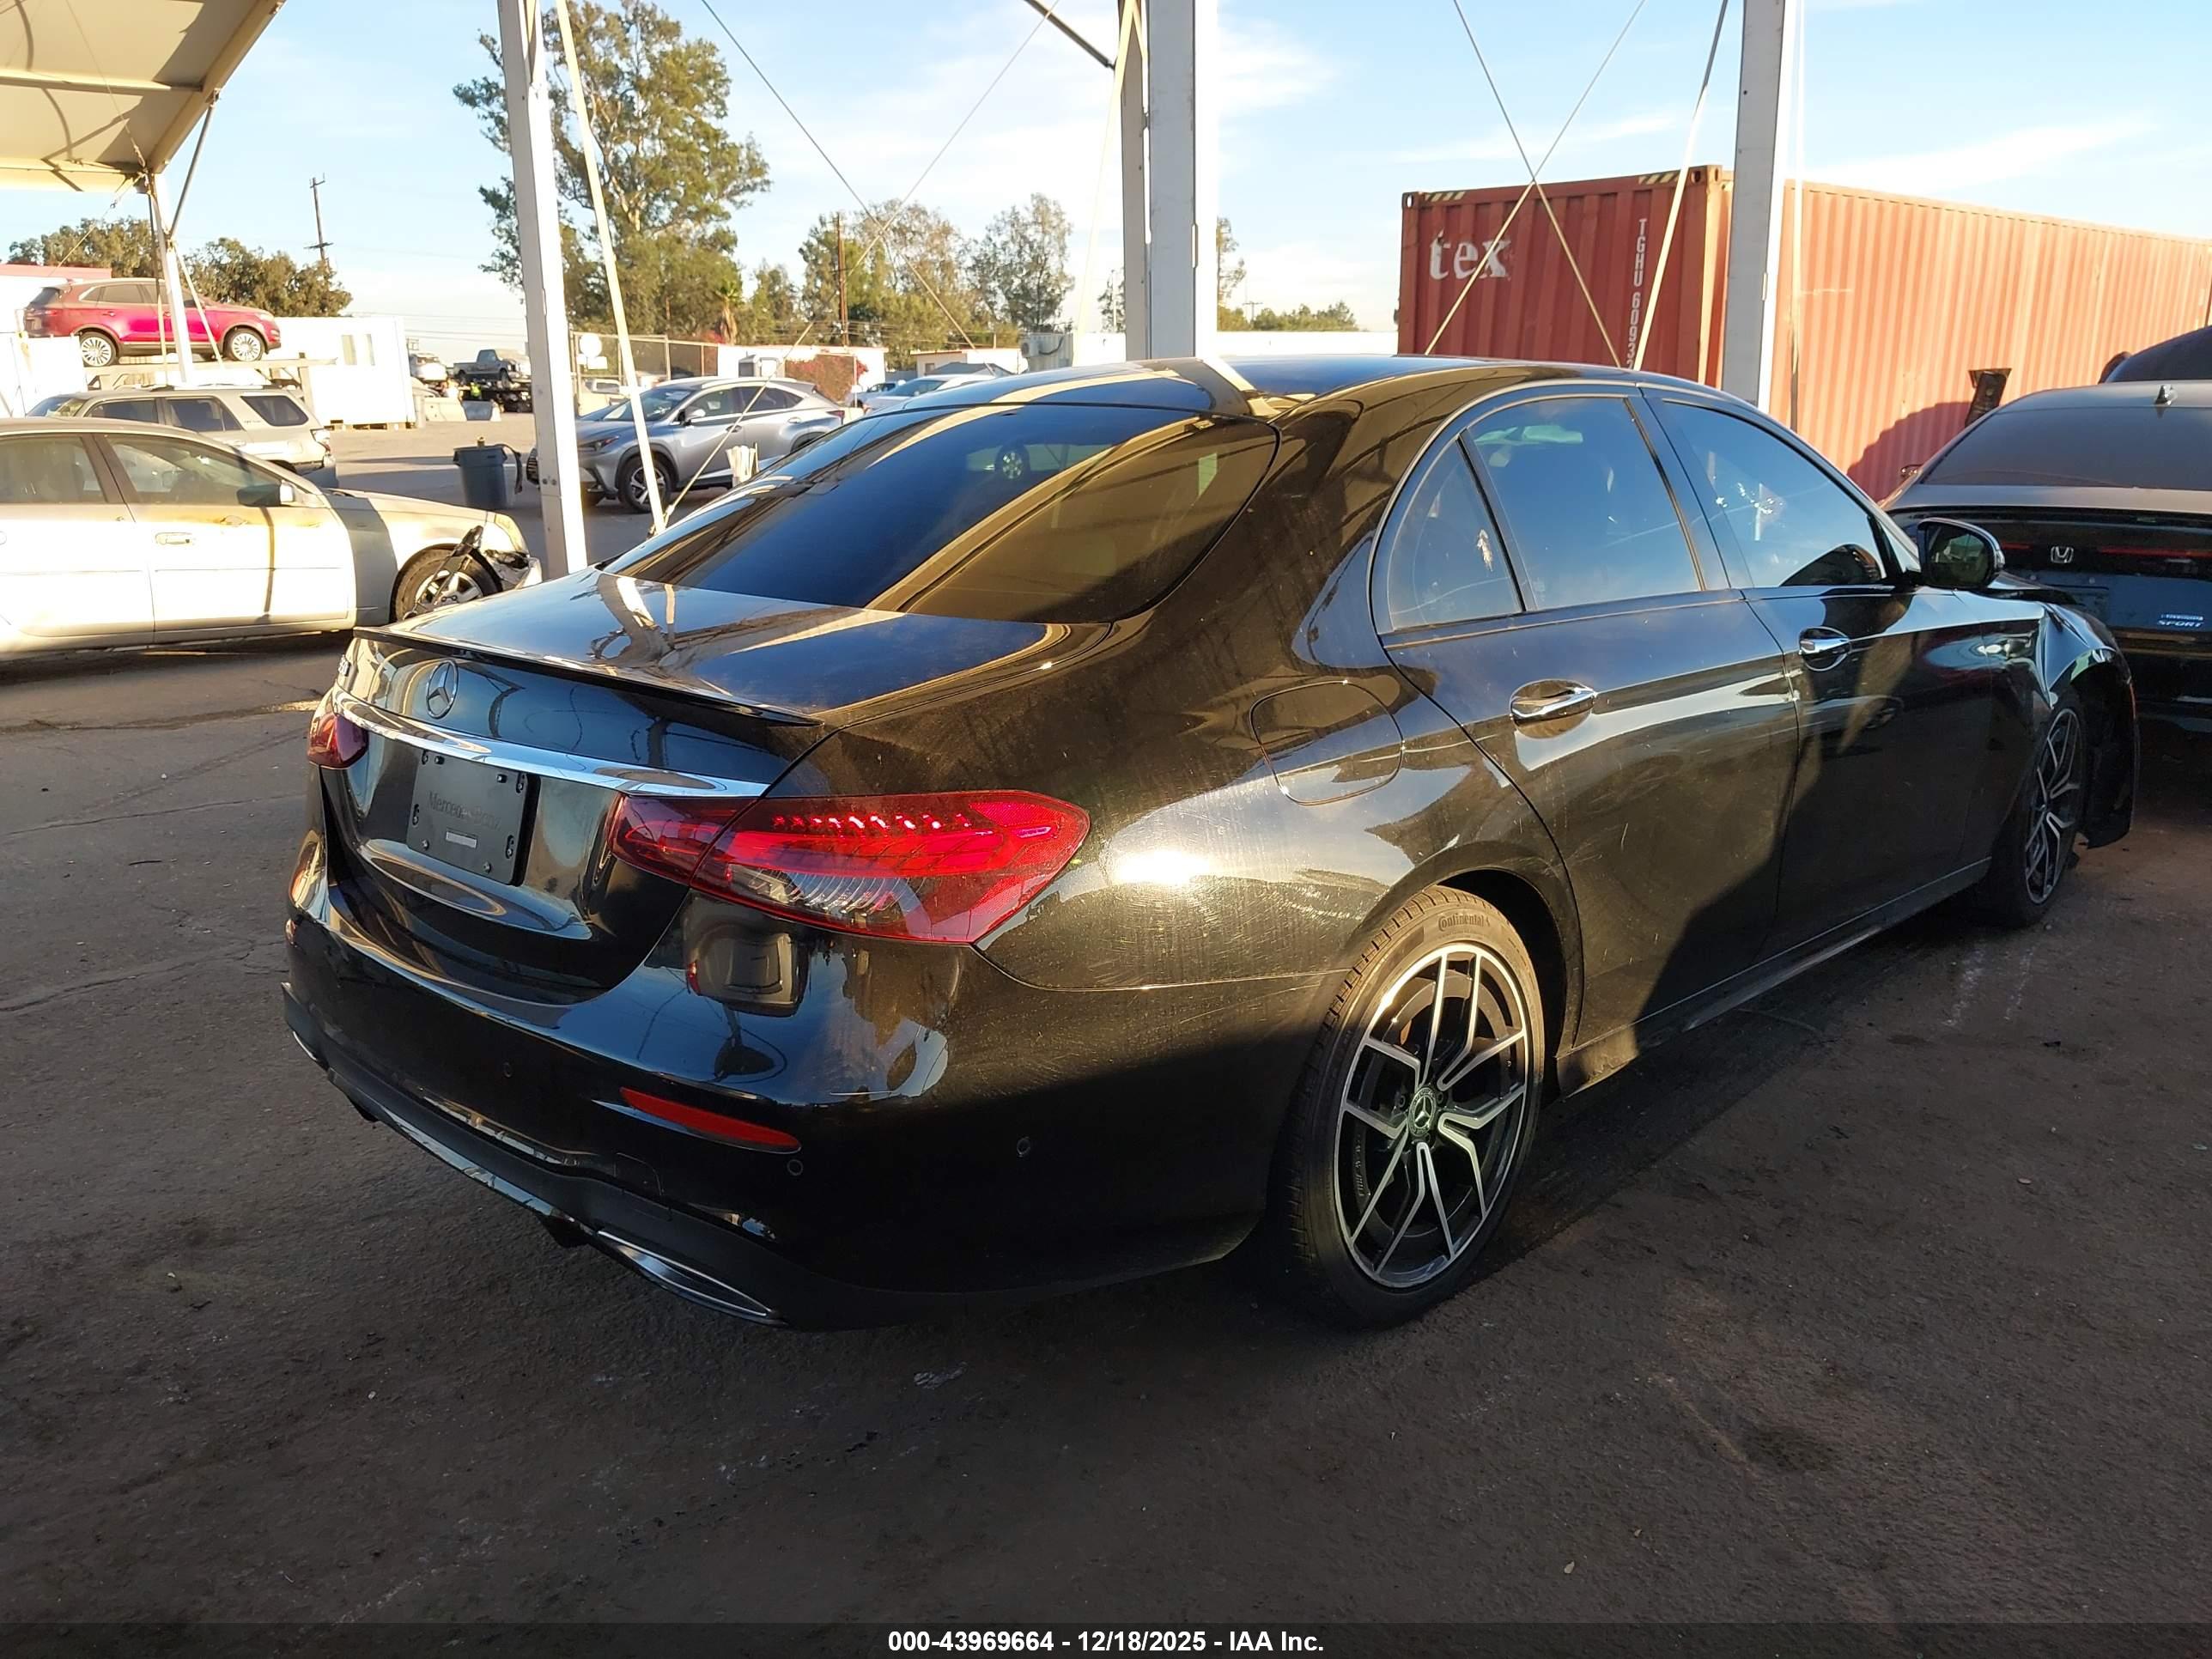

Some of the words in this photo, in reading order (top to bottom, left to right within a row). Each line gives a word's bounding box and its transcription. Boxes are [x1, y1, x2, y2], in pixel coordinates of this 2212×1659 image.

[1429, 228, 1511, 280] tex
[1633, 218, 1648, 287] TGHU
[1438, 913, 1485, 932] Continental
